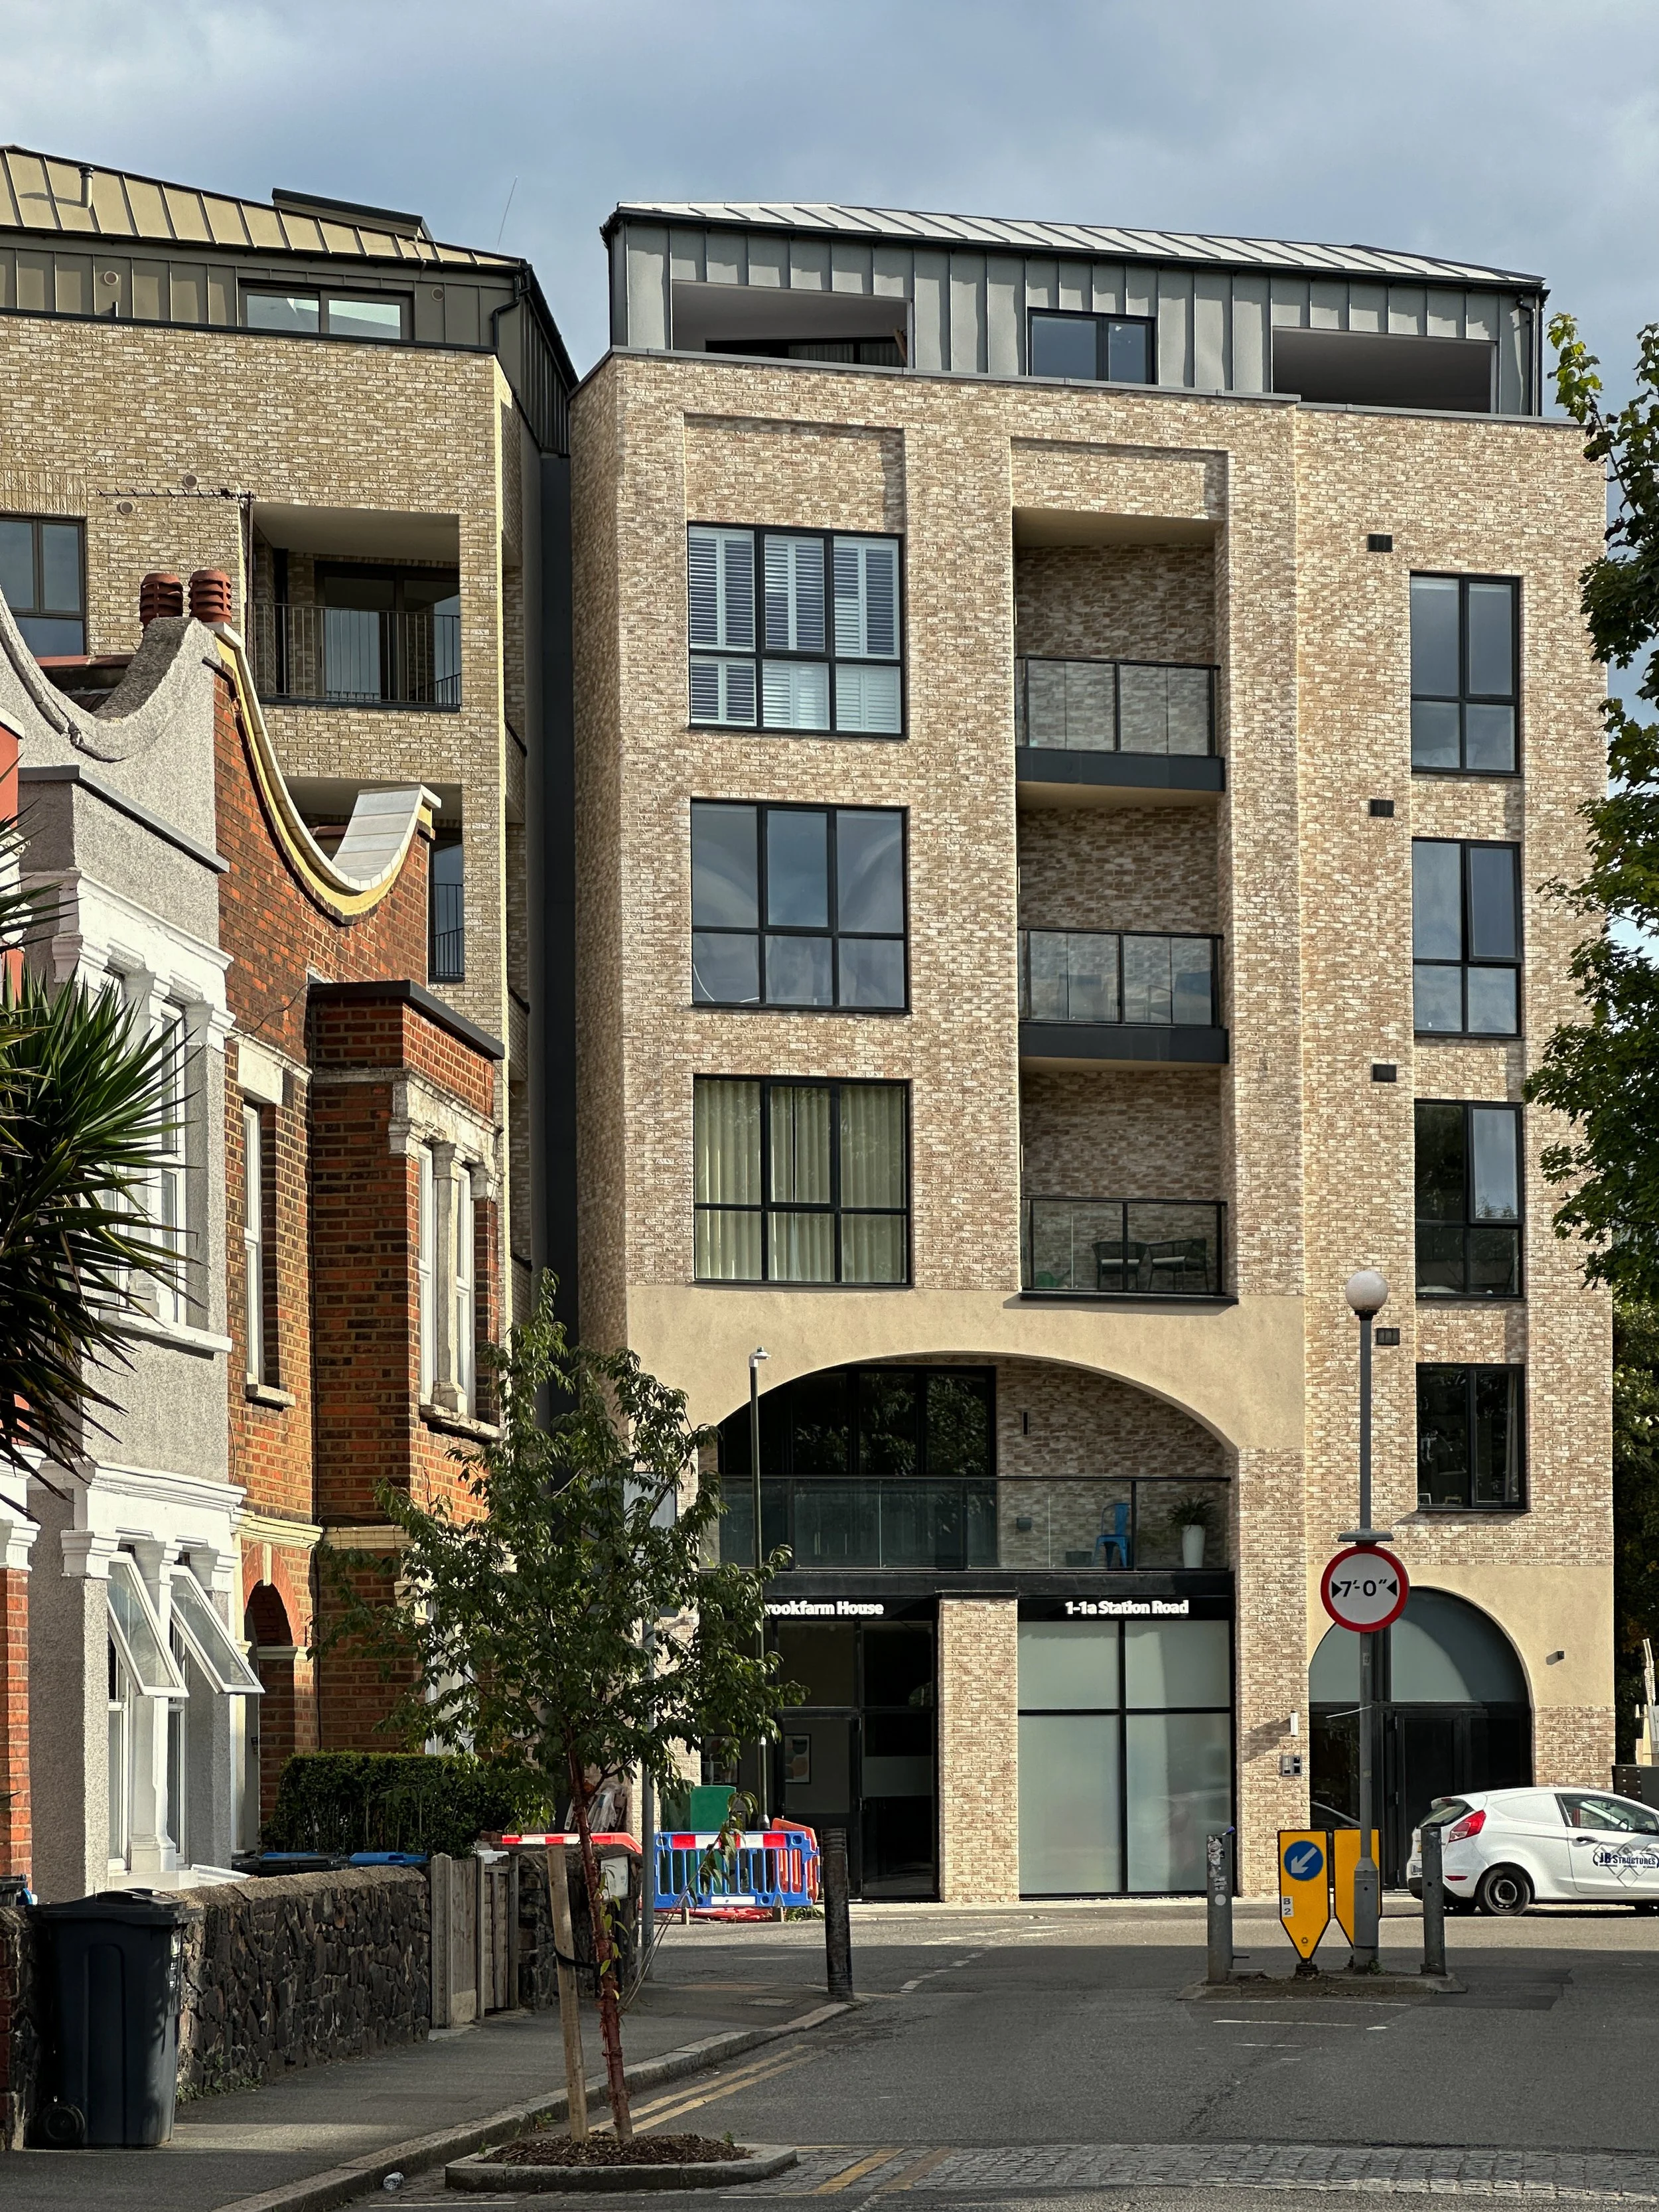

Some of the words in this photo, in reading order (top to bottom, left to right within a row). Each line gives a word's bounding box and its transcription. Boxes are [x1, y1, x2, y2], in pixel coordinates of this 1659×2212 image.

[765, 1601, 835, 1615] rookfarm
[836, 1601, 884, 1615] House
[1065, 1601, 1098, 1615] 1-1a
[1098, 1600, 1151, 1614] Station
[1151, 1600, 1189, 1614] Road
[1599, 1852, 1611, 1863] JB
